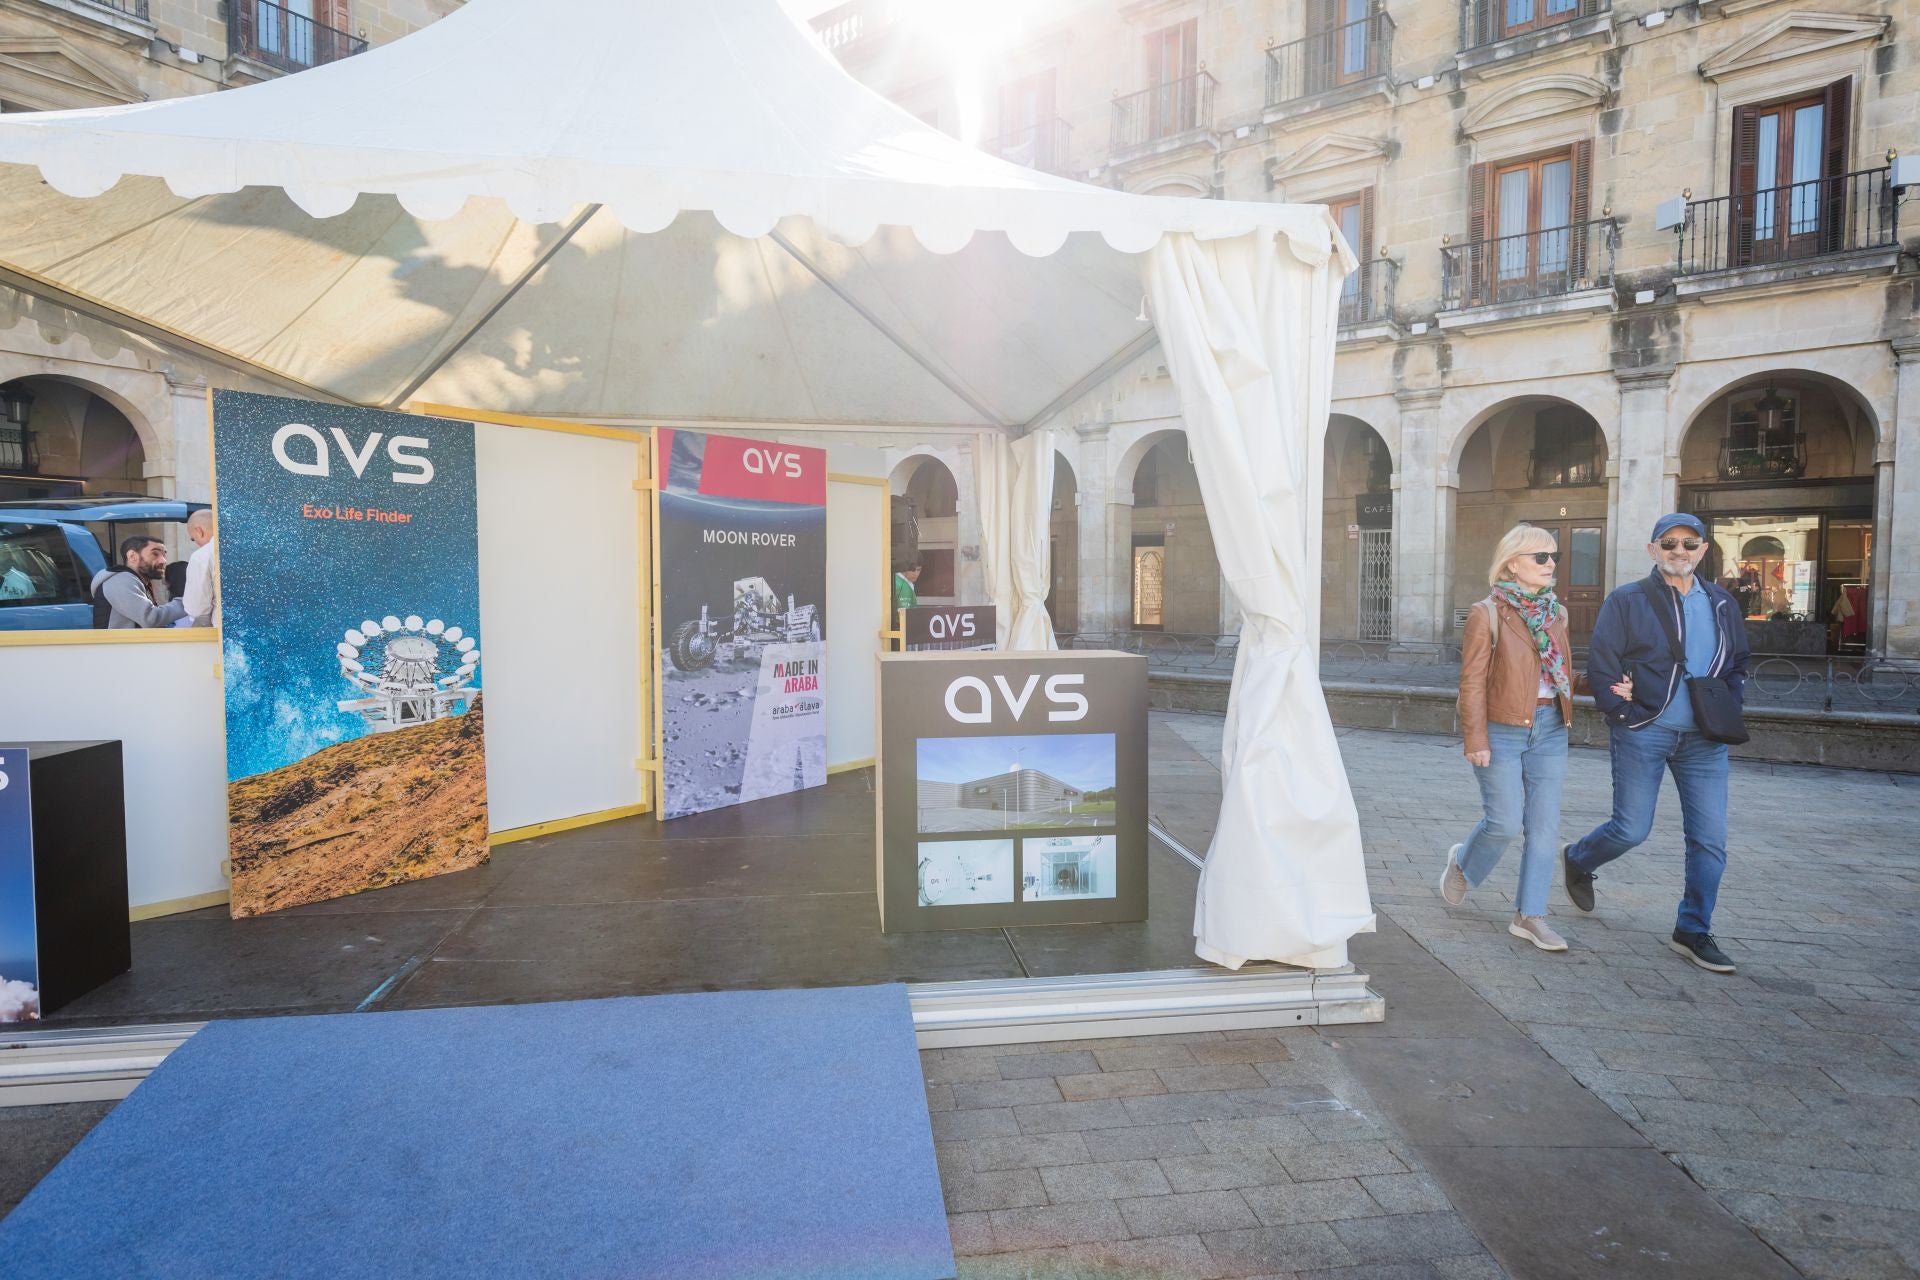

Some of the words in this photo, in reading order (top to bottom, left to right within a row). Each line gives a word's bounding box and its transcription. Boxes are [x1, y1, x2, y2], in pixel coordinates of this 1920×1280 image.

[303, 504, 332, 519] Exo
[335, 507, 363, 521] Life
[366, 509, 413, 524] Finder
[1560, 507, 1567, 516] 8
[703, 529, 748, 545] MOON
[751, 532, 796, 547] ROVER
[773, 660, 805, 678] MADE
[808, 659, 818, 675] IN
[784, 675, 818, 694] ARABA
[772, 704, 794, 715] araba
